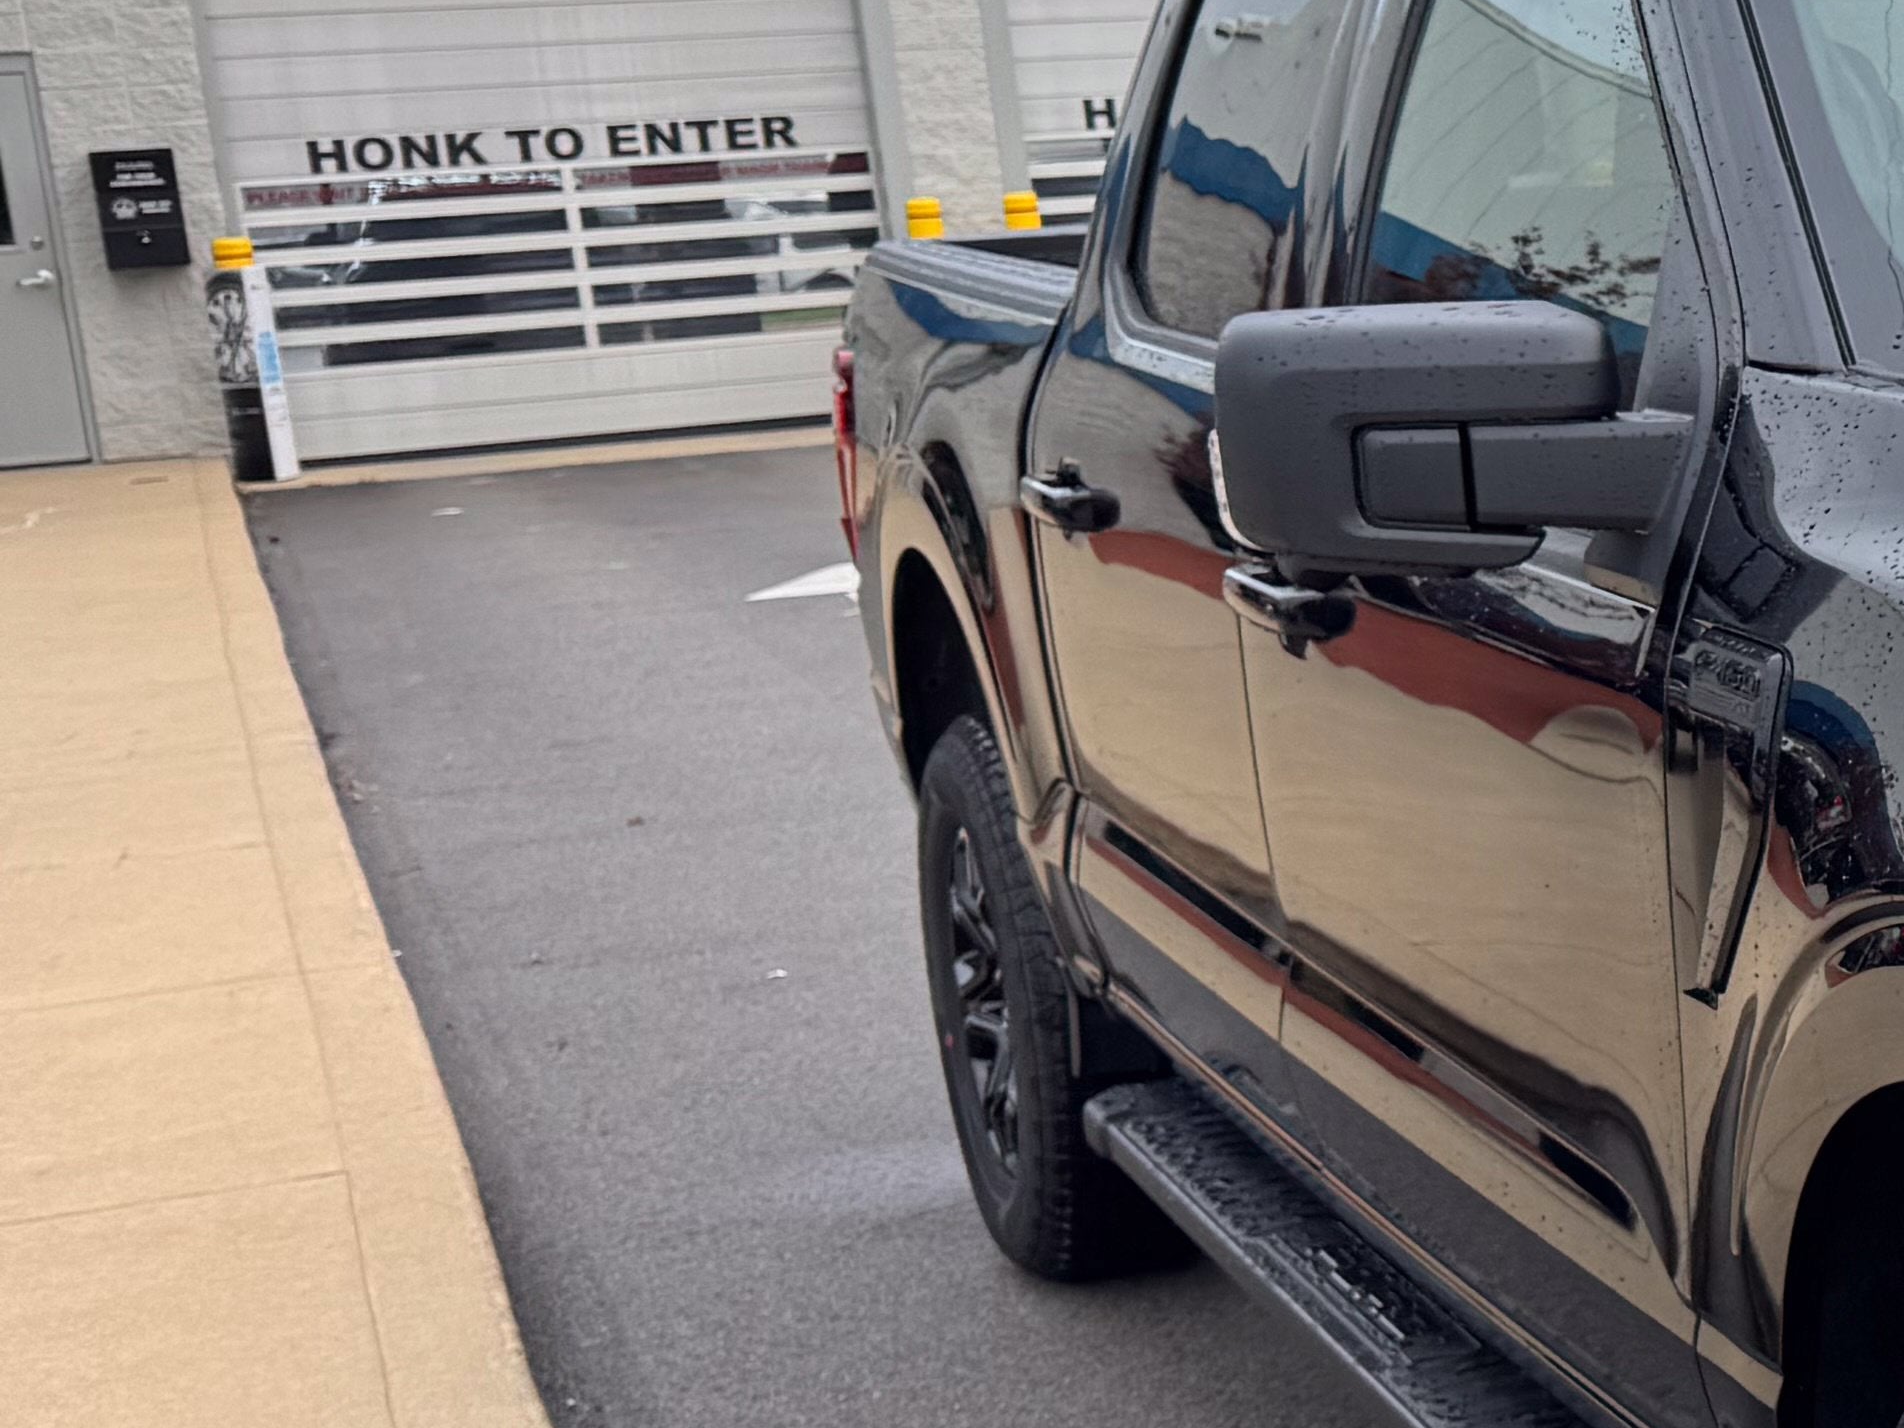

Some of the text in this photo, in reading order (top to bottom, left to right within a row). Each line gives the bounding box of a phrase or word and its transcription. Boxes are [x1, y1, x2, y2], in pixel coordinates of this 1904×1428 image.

[306, 115, 798, 174] HONK TO ENTER
